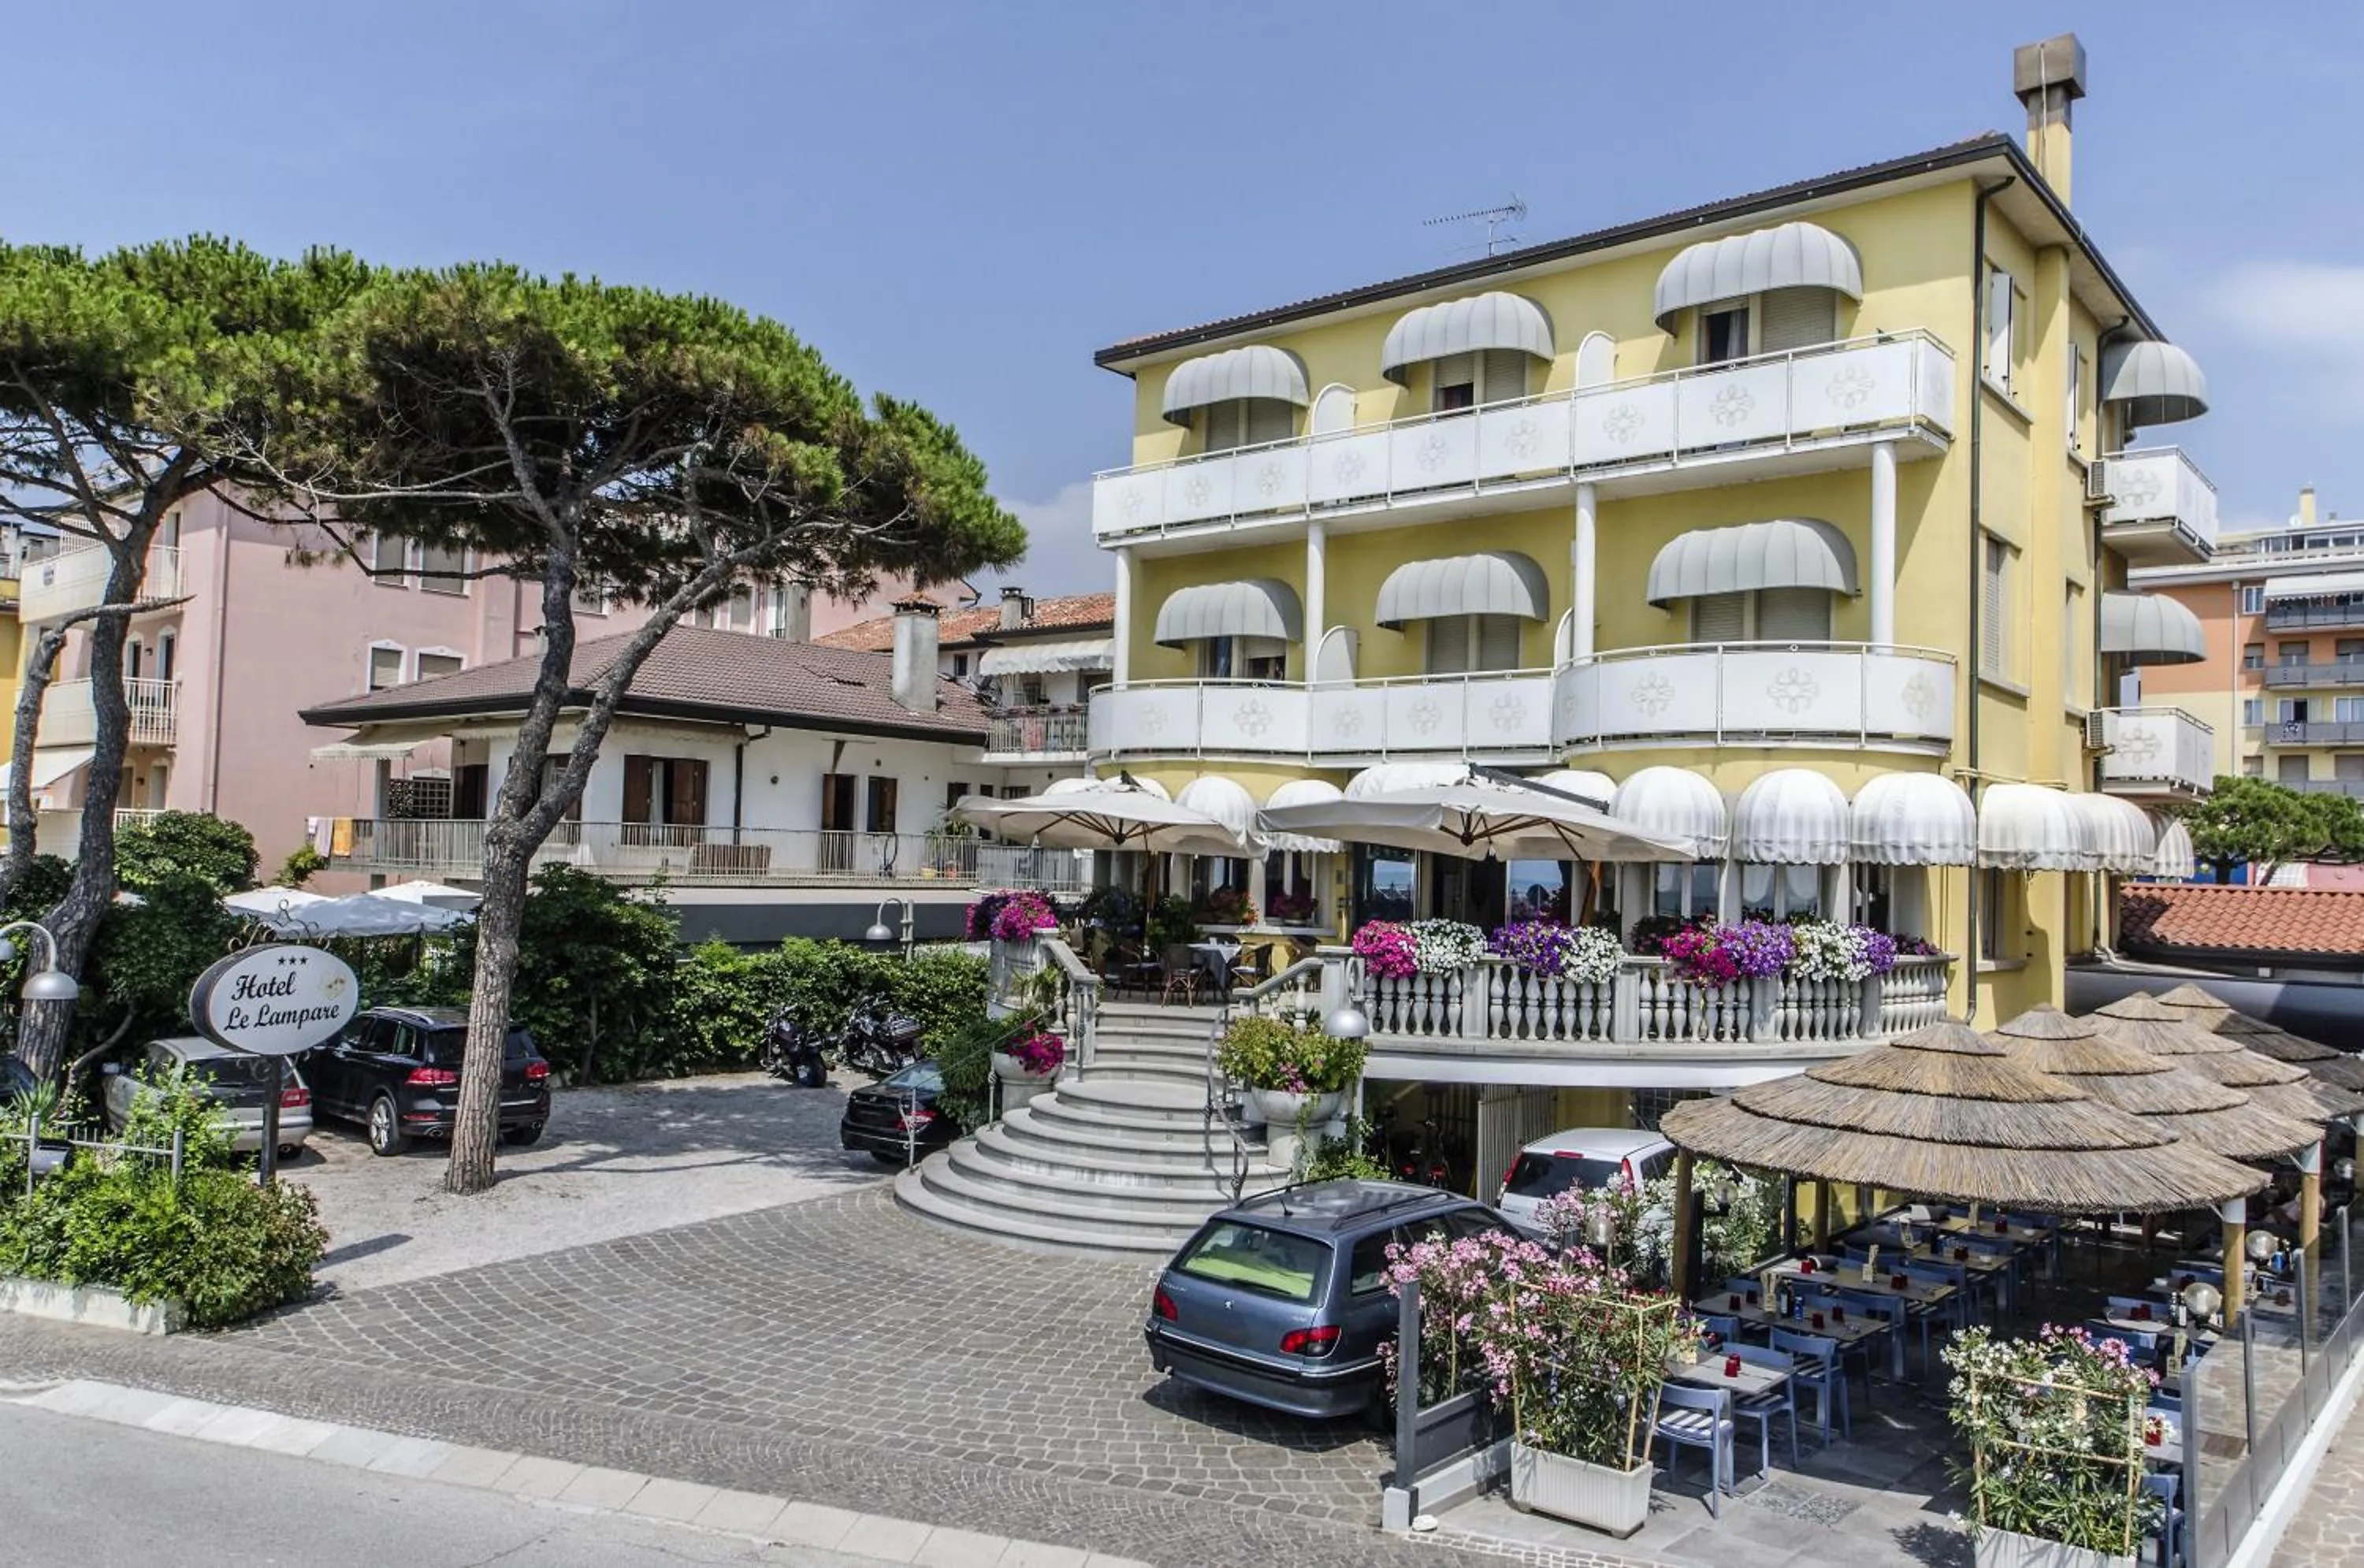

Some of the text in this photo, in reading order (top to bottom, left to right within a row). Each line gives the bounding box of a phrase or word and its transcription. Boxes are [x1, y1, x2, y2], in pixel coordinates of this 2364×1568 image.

[231, 971, 296, 1001] Hotel
[224, 1004, 340, 1031] Le Lampare
